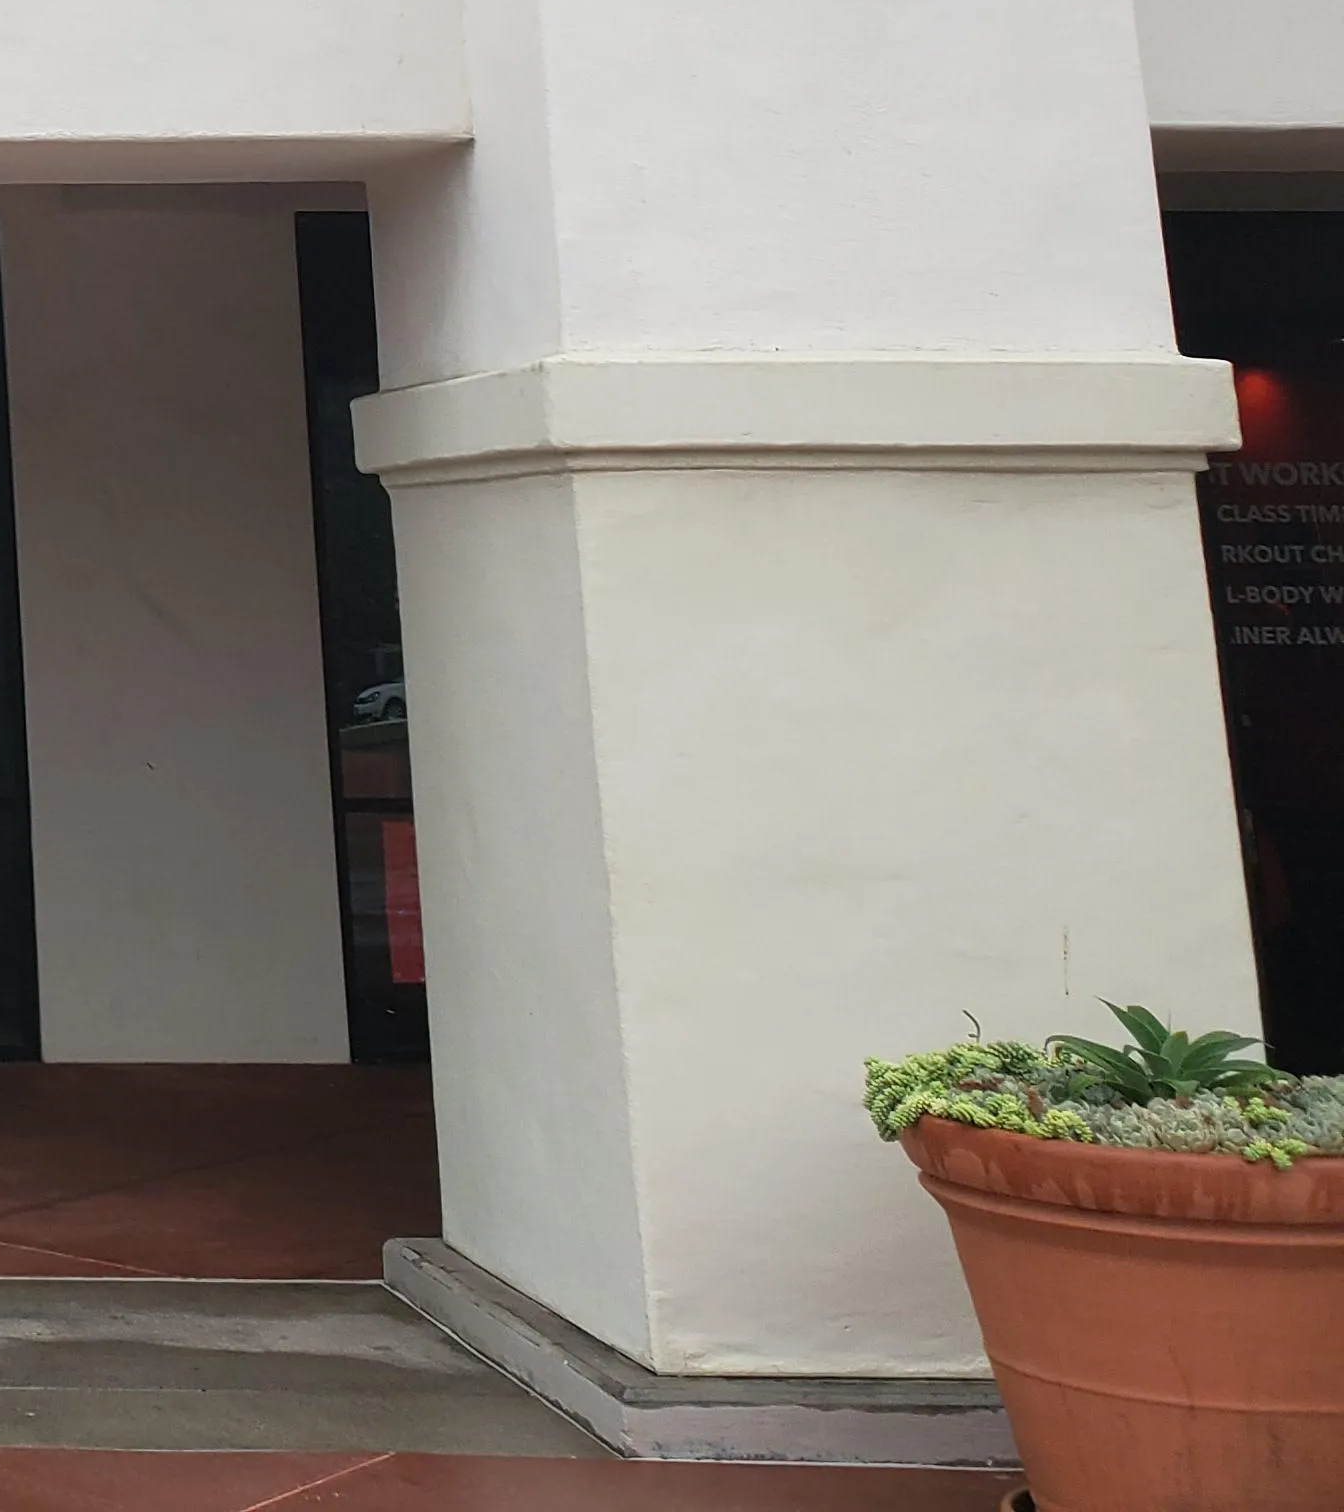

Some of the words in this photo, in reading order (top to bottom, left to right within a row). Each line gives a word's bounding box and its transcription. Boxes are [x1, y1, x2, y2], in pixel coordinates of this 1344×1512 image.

[1238, 461, 1344, 486] WORK
[1216, 504, 1292, 524] CLASS
[1295, 504, 1344, 524] TIM
[1220, 544, 1305, 564] RKOUT
[1226, 585, 1314, 604] L-BODY
